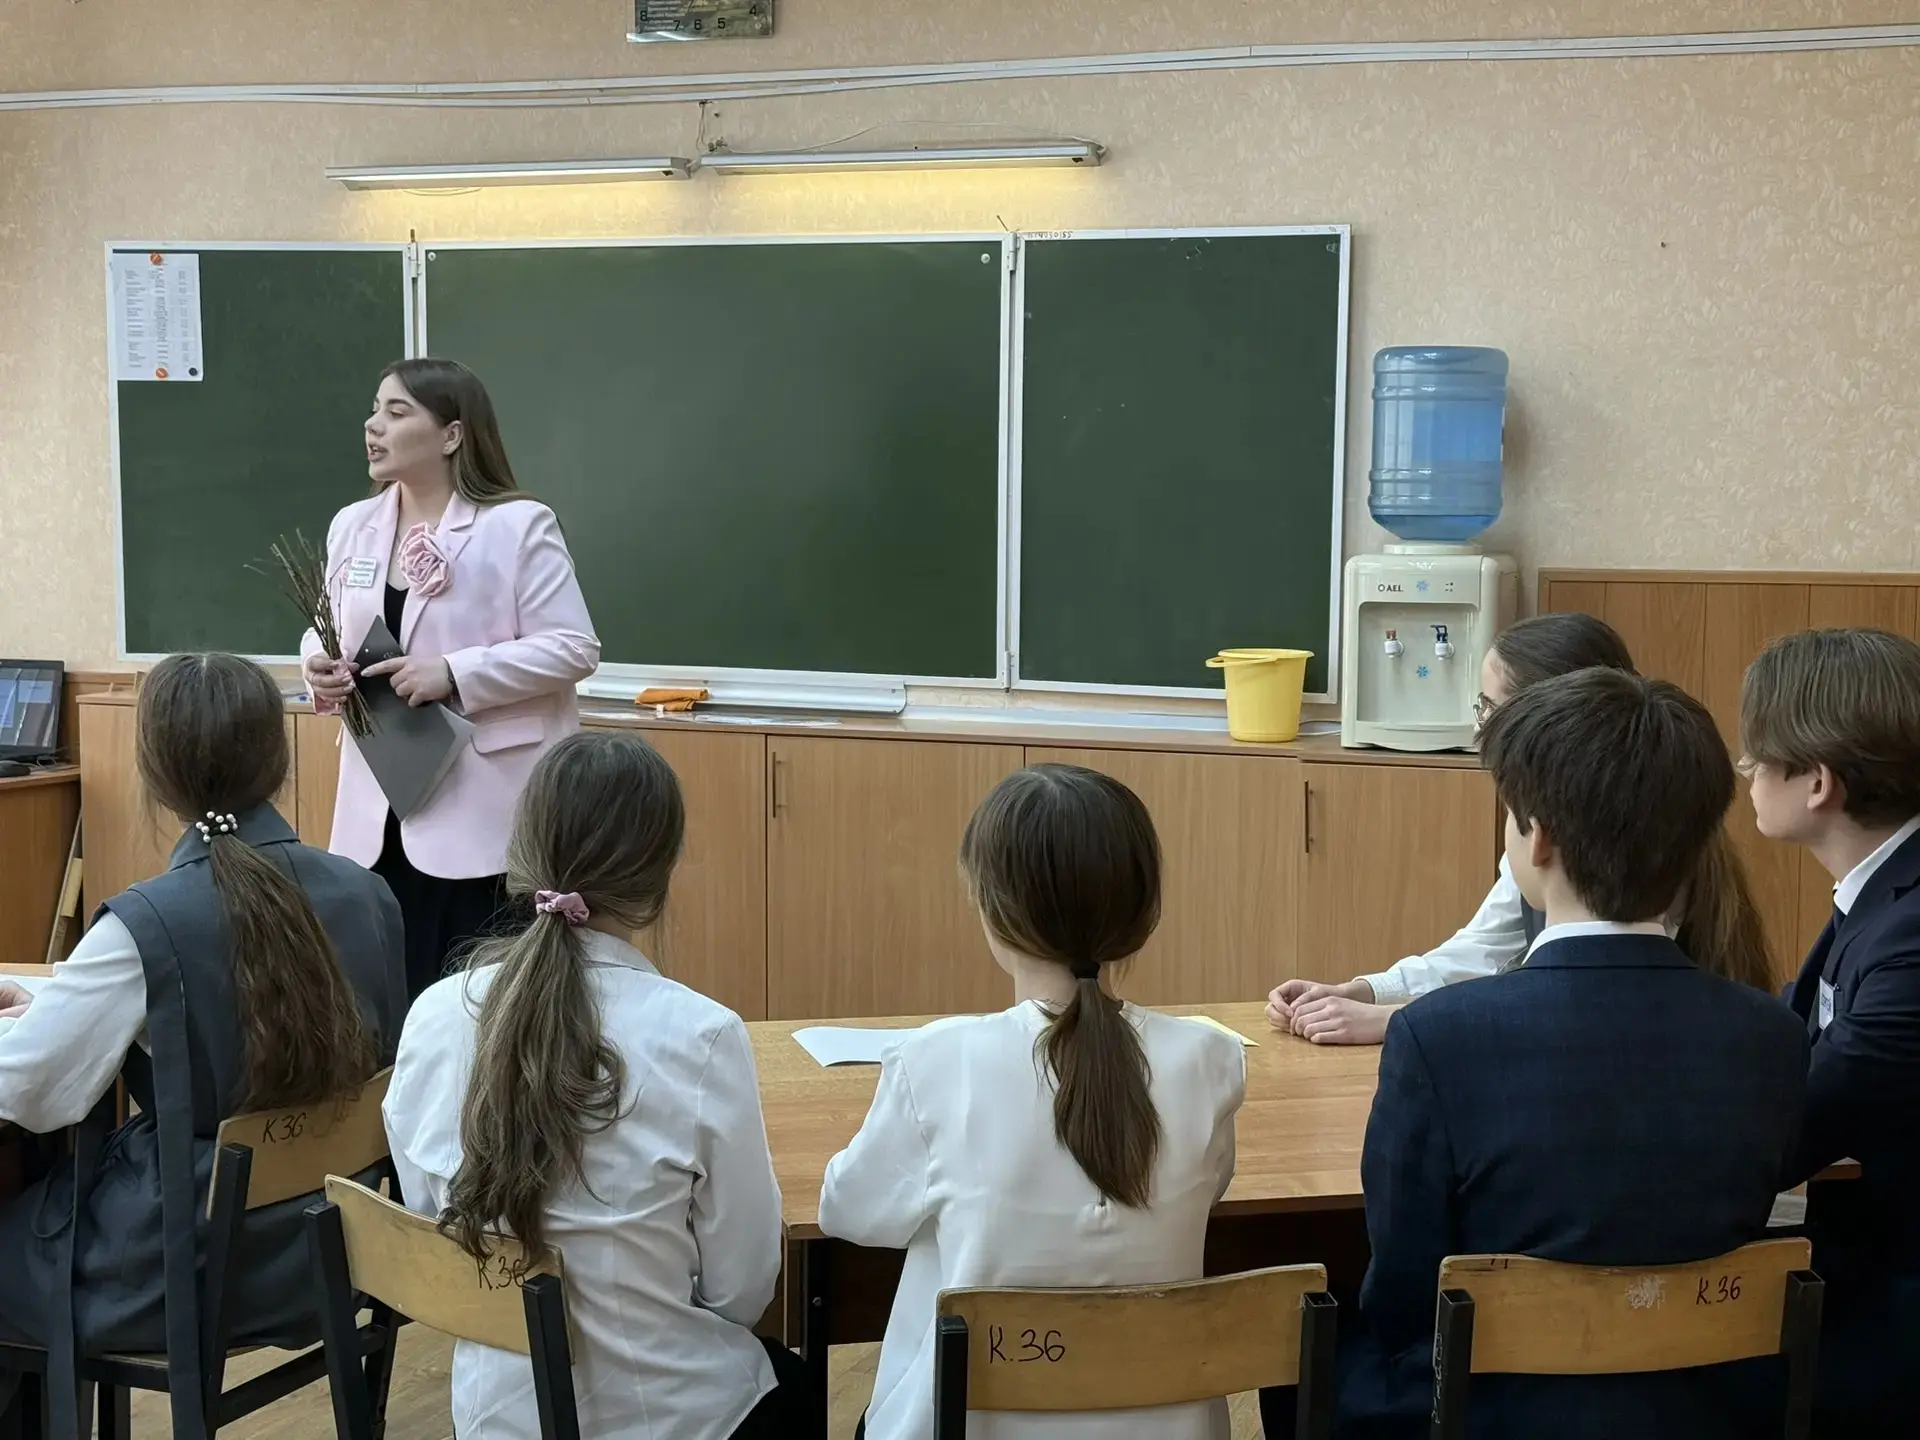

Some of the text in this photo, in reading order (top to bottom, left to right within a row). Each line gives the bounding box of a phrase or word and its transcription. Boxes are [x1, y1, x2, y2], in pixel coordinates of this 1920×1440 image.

[640, 10, 648, 22] 8
[750, 4, 757, 16] 4
[673, 20, 682, 31] 7
[694, 19, 702, 31] 6
[717, 17, 726, 29] 5
